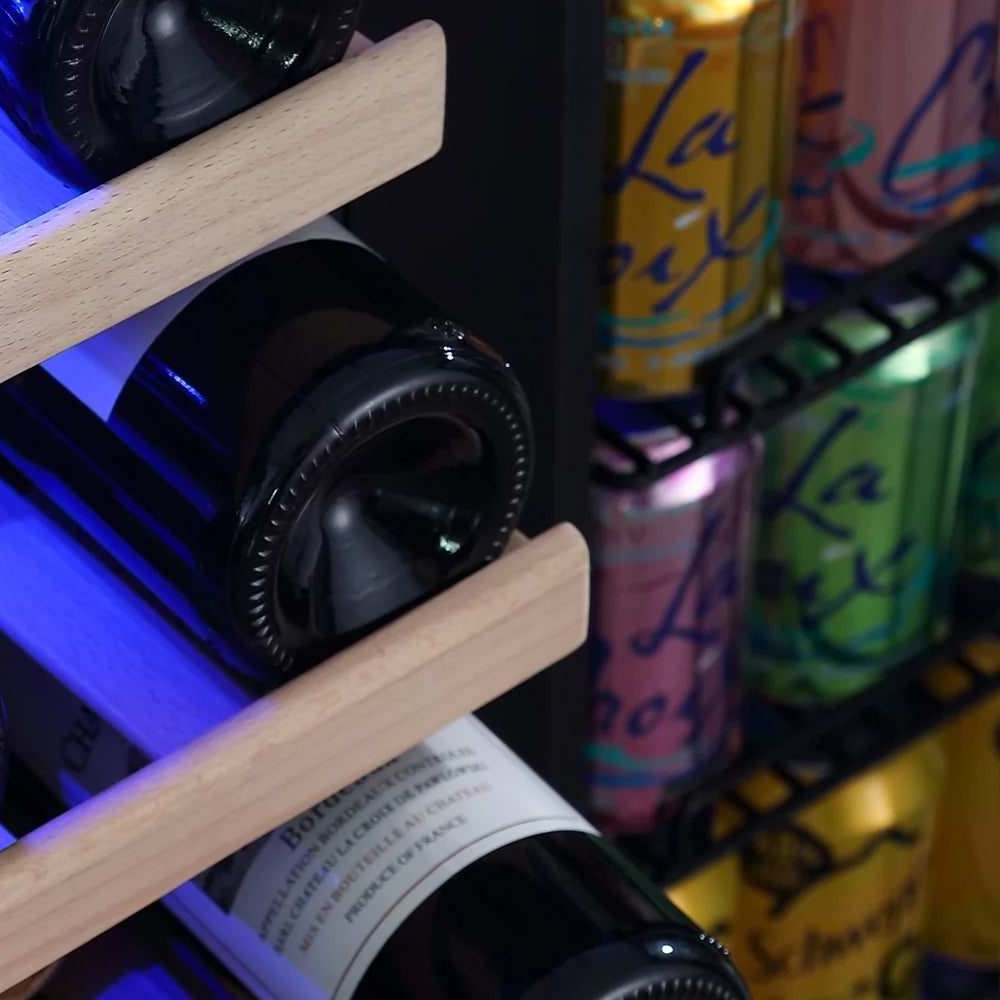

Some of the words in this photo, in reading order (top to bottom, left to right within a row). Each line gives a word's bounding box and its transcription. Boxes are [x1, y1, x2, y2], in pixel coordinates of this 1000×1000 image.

[257, 846, 320, 940] APPELLATION
[317, 777, 397, 848] BORDEAUX
[293, 854, 339, 921] CHATEAU
[336, 837, 355, 857] LA
[353, 802, 395, 841] CROIX
[393, 788, 415, 806] DE
[299, 923, 320, 954] MIS
[314, 902, 334, 925] EN
[330, 827, 406, 903] BOUTEILLE
[404, 811, 425, 831] AU
[343, 863, 398, 924] PRODUCE
[396, 849, 415, 866] OF
[413, 813, 468, 851] FRANCE
